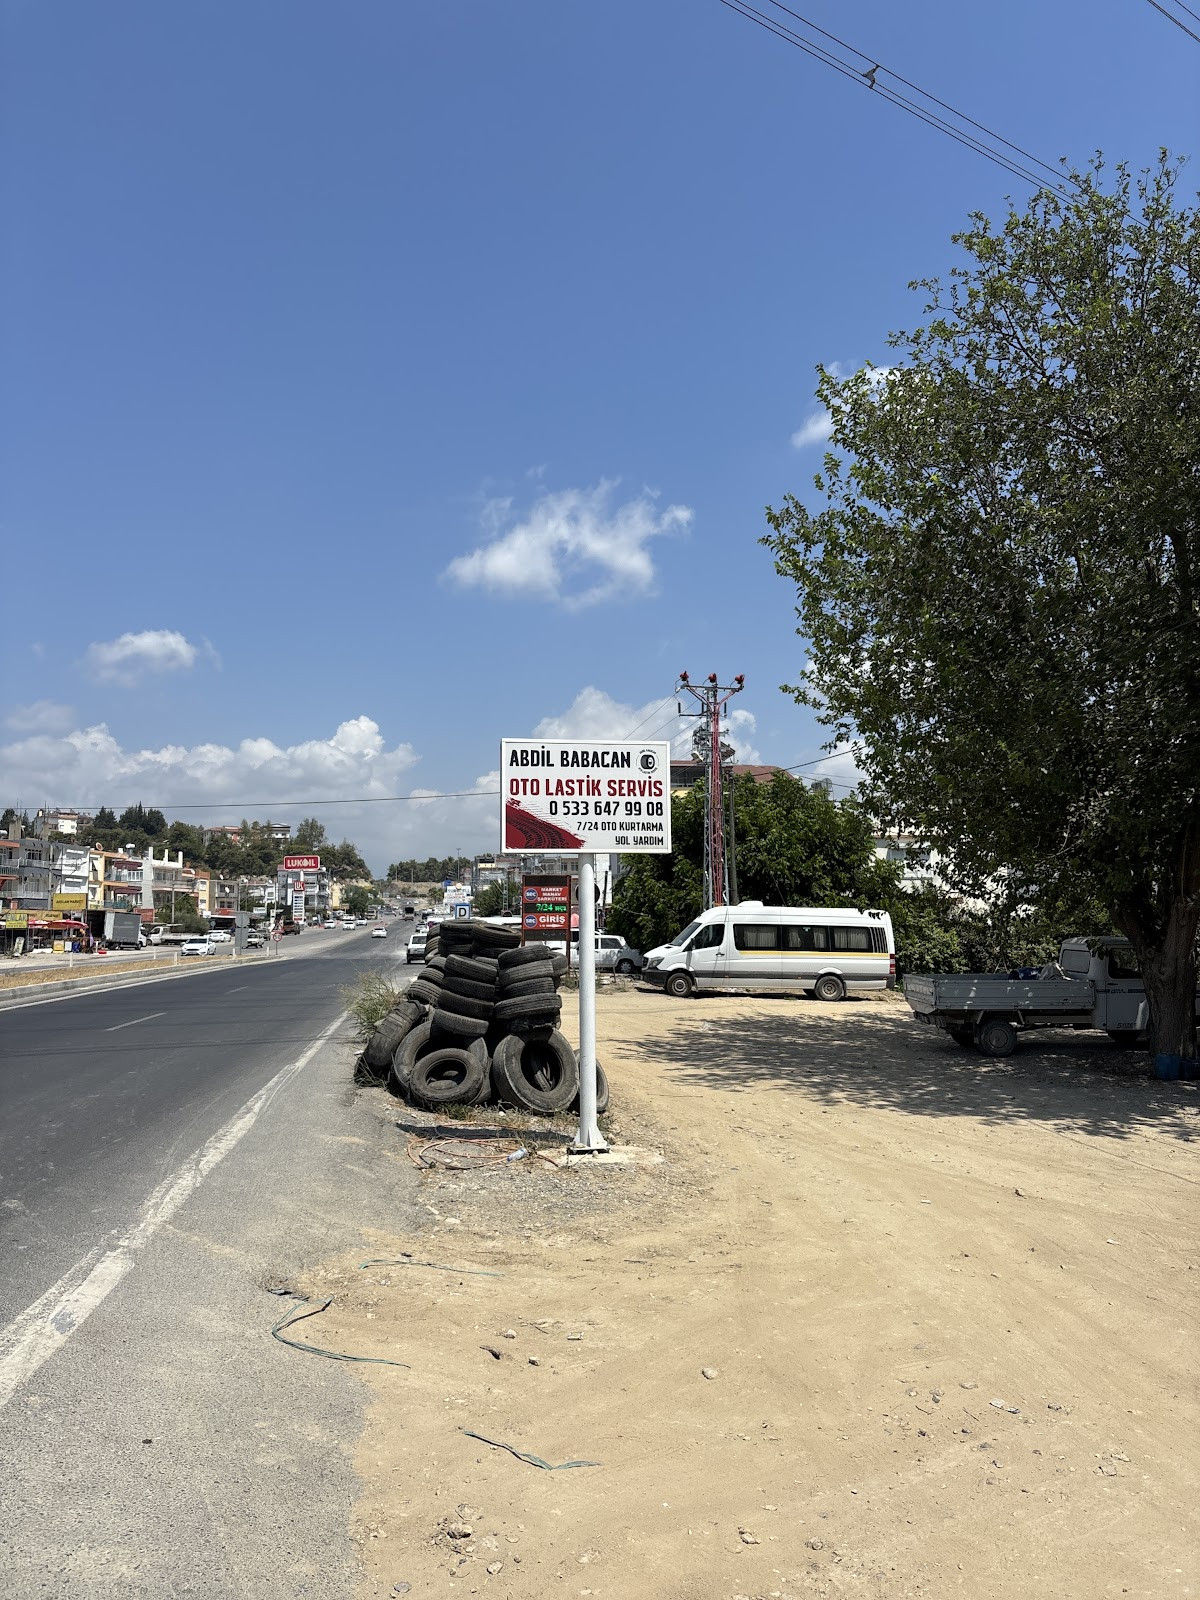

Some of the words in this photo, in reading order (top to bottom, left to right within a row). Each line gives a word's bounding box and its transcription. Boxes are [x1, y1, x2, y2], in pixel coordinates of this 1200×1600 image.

[510, 746, 554, 767] ABDİL
[560, 750, 630, 768] BABACAN
[510, 778, 540, 796] OTO
[546, 774, 602, 796] LASTİK
[607, 776, 663, 797] SERVİS
[550, 800, 558, 815] 0
[562, 801, 589, 816] 533
[594, 801, 620, 816] 647
[625, 802, 641, 816] 99
[646, 802, 663, 816] 08
[577, 821, 598, 831] 7/24
[602, 822, 616, 831] OTO
[619, 822, 664, 832] KURTARMA
[615, 836, 630, 845] YOL
[633, 836, 664, 845] YARDIM
[459, 908, 466, 916] D
[539, 915, 566, 924] GİRİŞ
